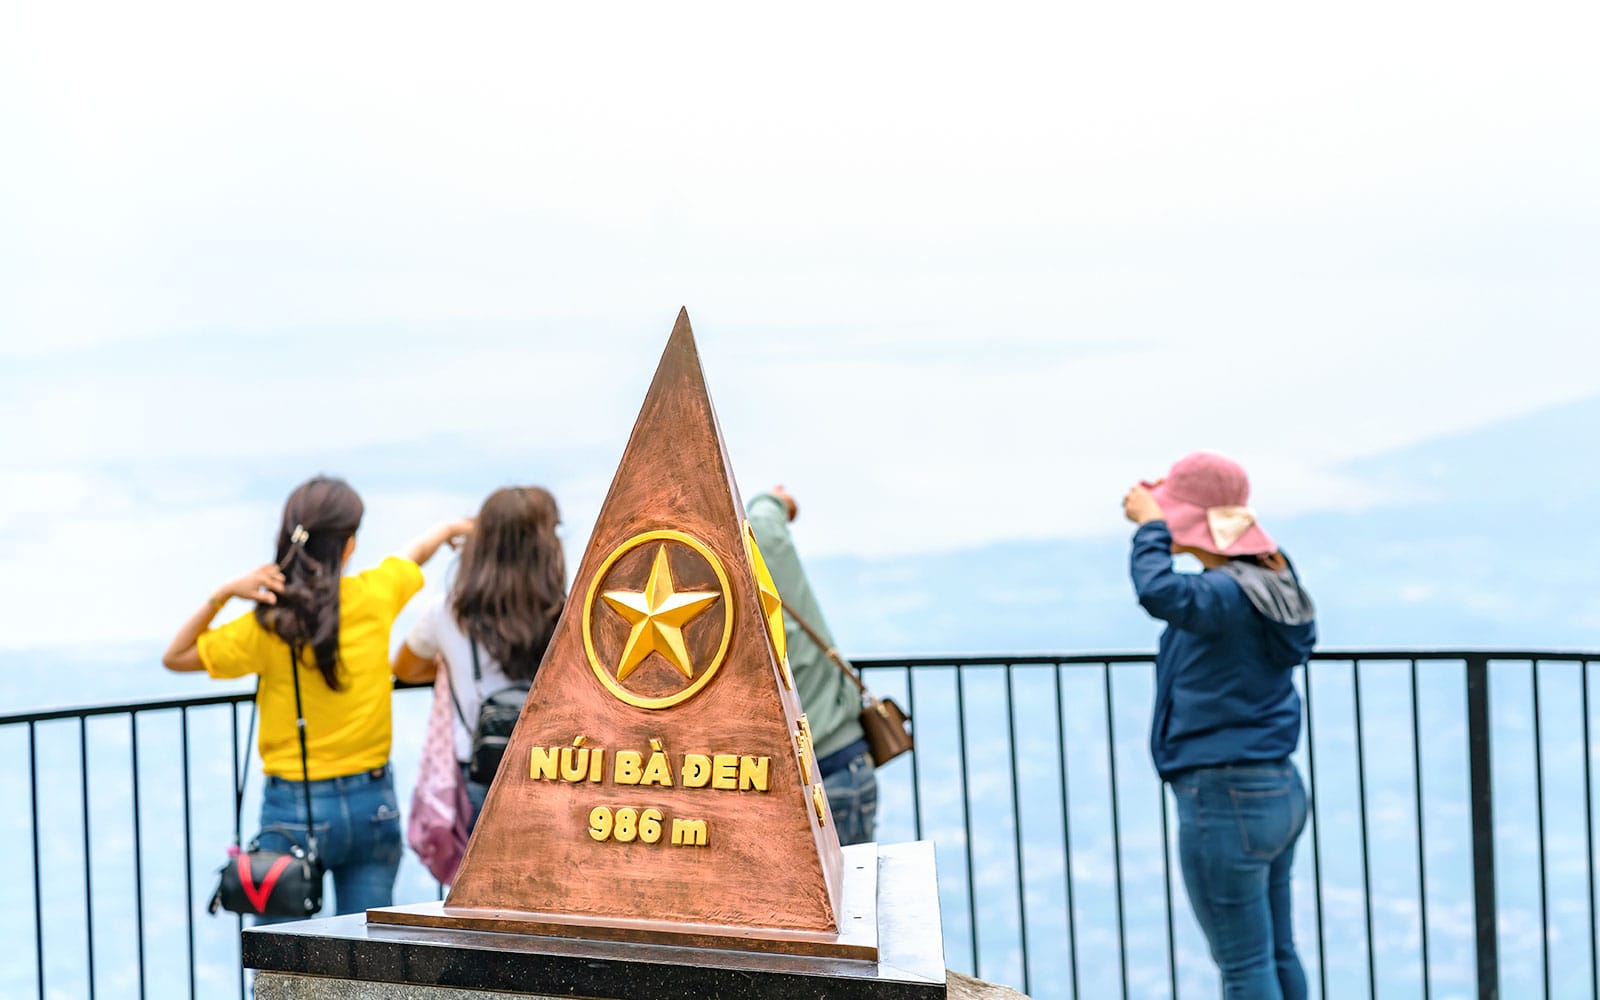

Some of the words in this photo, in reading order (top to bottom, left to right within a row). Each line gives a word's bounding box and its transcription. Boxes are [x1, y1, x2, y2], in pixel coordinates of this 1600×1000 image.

[529, 735, 605, 783] NÚI
[614, 738, 675, 787] BÀ
[681, 753, 771, 792] ĐEN
[588, 806, 664, 844] 986
[671, 817, 710, 847] m
